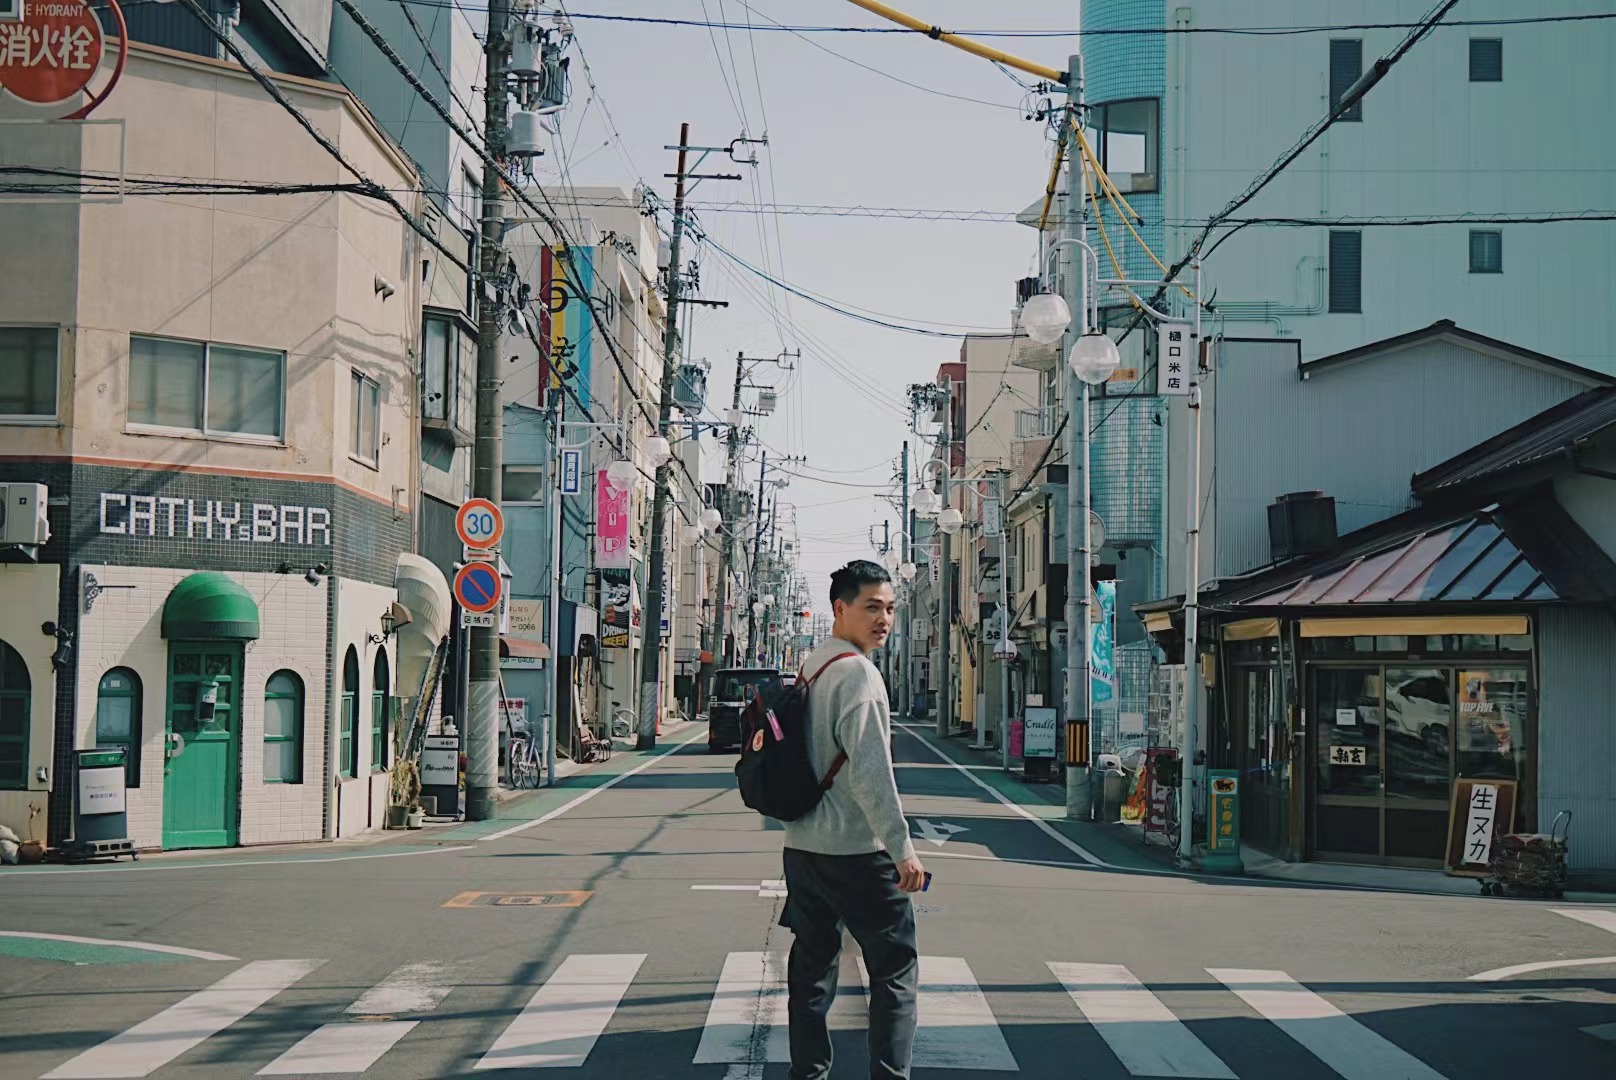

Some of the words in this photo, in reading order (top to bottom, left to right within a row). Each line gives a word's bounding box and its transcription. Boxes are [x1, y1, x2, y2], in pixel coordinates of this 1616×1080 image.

[36, 4, 84, 17] HYDRANT
[0, 23, 94, 69] 消火栓
[1168, 331, 1182, 389] 樋口米店
[252, 503, 331, 545] BAR
[467, 513, 493, 535] 30
[464, 615, 491, 624] 区域内
[1025, 718, 1055, 730] Cradle
[1469, 787, 1493, 861] 生ヌカ
